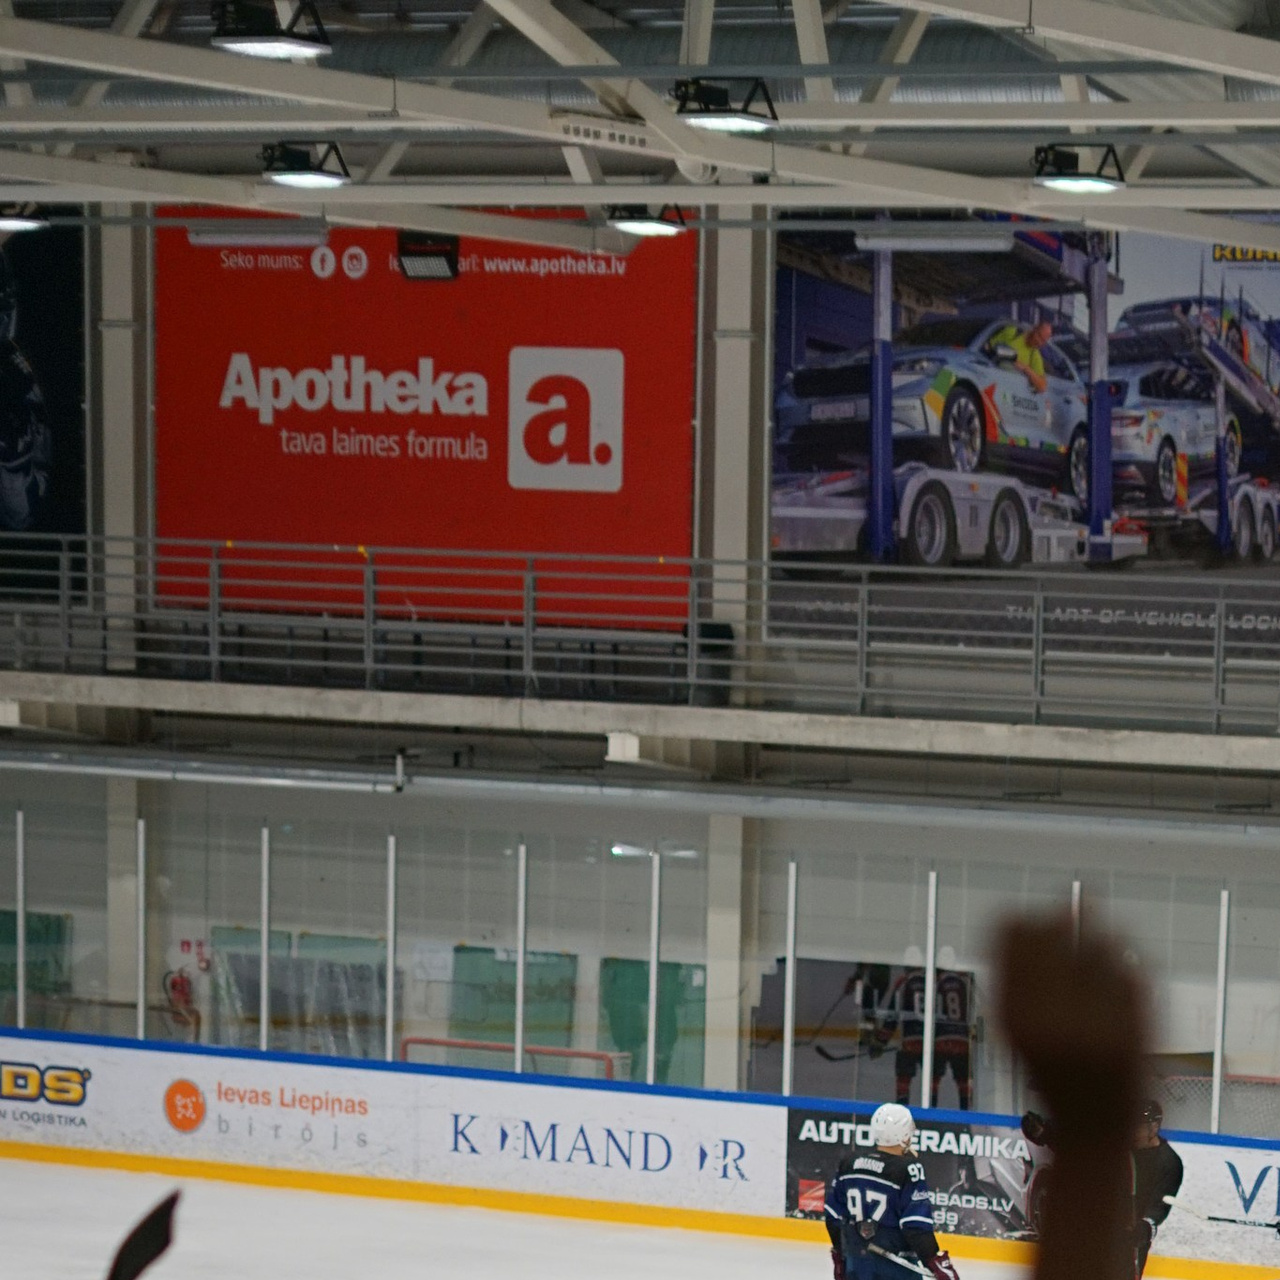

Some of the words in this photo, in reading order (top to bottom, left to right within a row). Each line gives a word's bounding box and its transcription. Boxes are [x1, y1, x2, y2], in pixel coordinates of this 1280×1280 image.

[220, 250, 255, 269] Seko
[258, 251, 303, 270] mums:
[484, 253, 626, 276] www.apotheka.lv
[219, 352, 489, 425] Apotheka
[280, 427, 326, 454] tava
[332, 427, 399, 457] laimes
[406, 430, 488, 460] formula
[217, 1081, 272, 1107] Ievas
[798, 1119, 1031, 1161] AUTOERAMIKA
[846, 1188, 888, 1222] 97
